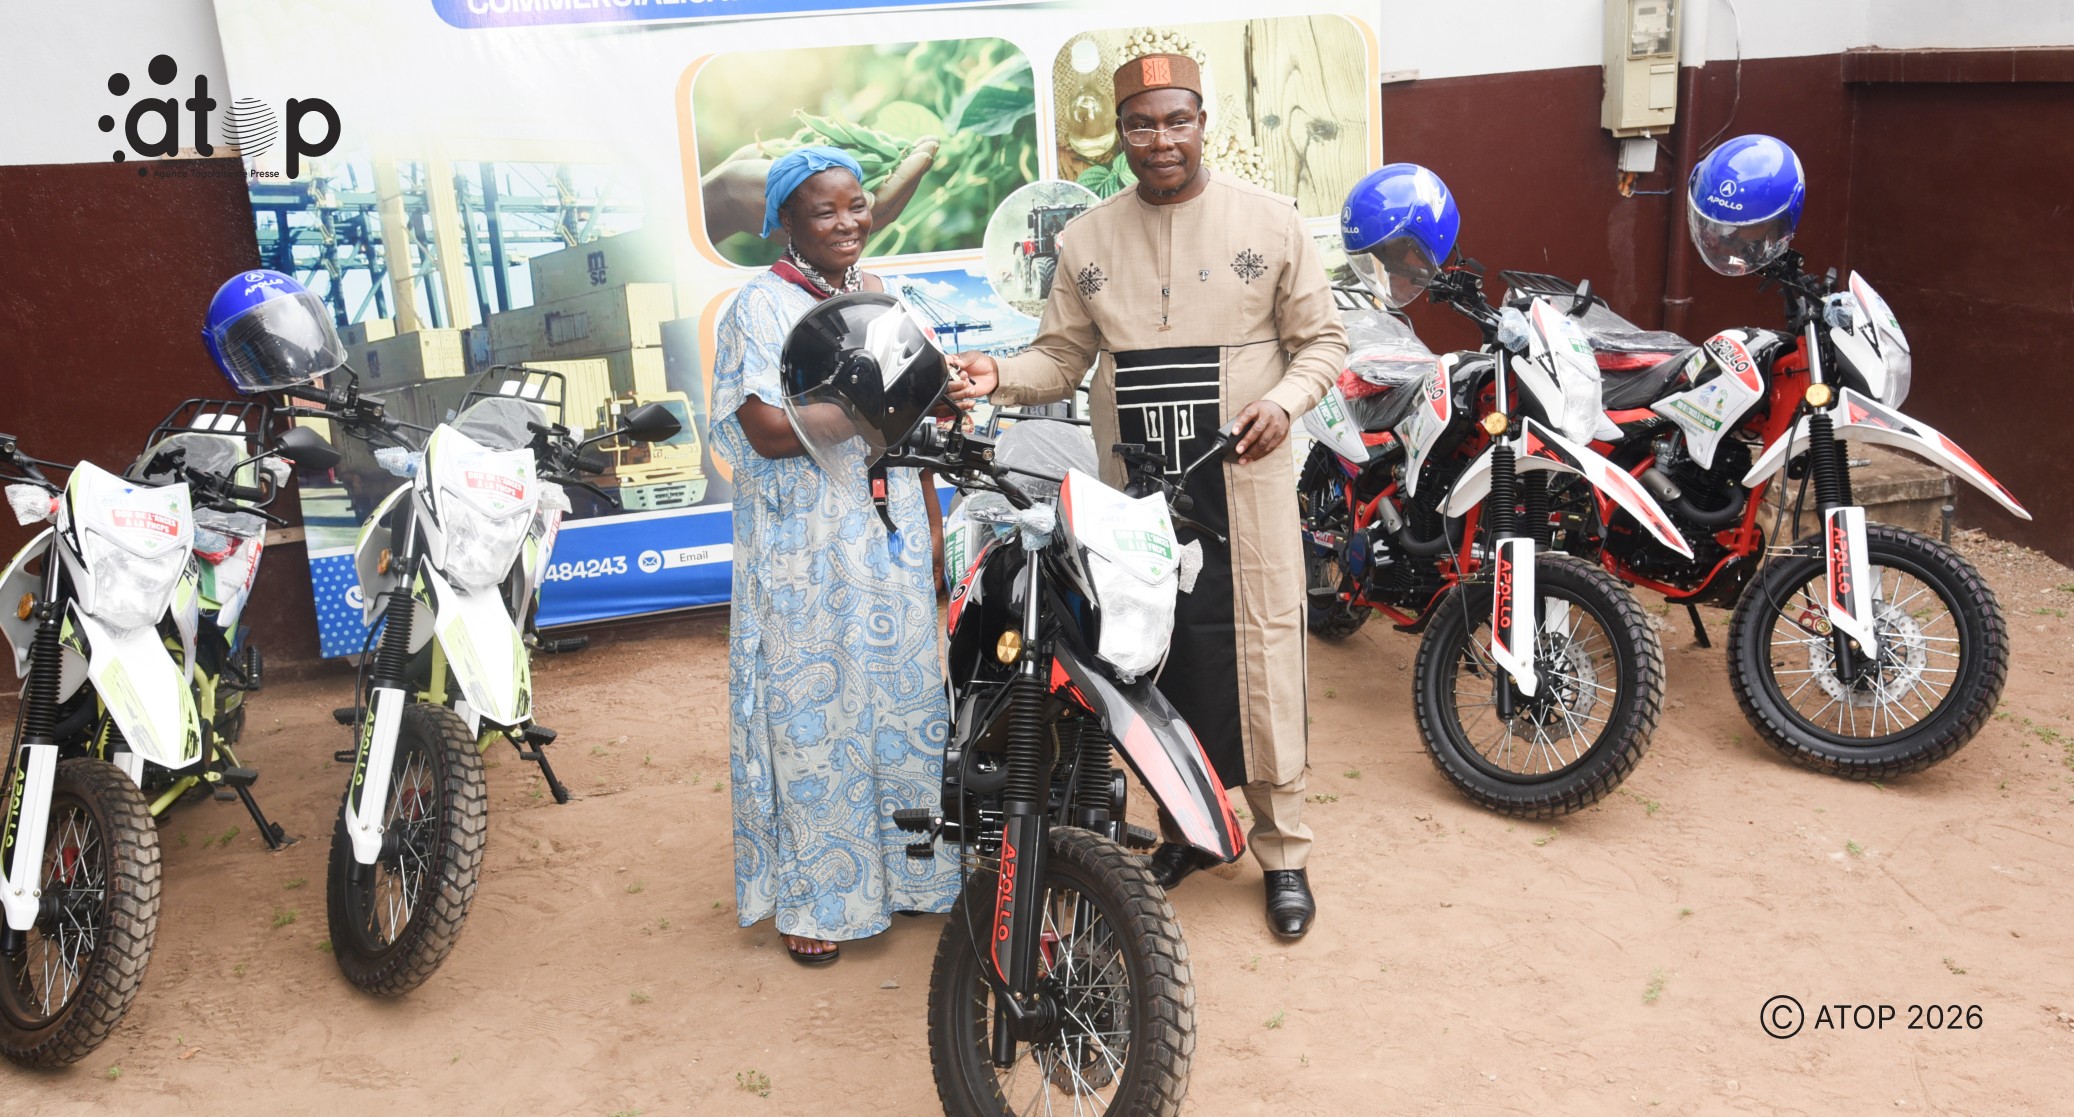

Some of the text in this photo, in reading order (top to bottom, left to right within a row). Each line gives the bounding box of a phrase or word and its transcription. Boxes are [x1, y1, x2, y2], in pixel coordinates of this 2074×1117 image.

[1707, 194, 1743, 211] APOLLO
[541, 555, 628, 583] 484243
[679, 551, 709, 563] Email
[1833, 527, 1850, 594] APOLLO
[1500, 559, 1514, 629] APOLLO
[355, 710, 375, 786] APOLLO
[6, 767, 25, 848] APOLLO
[998, 842, 1017, 941] APOLLO
